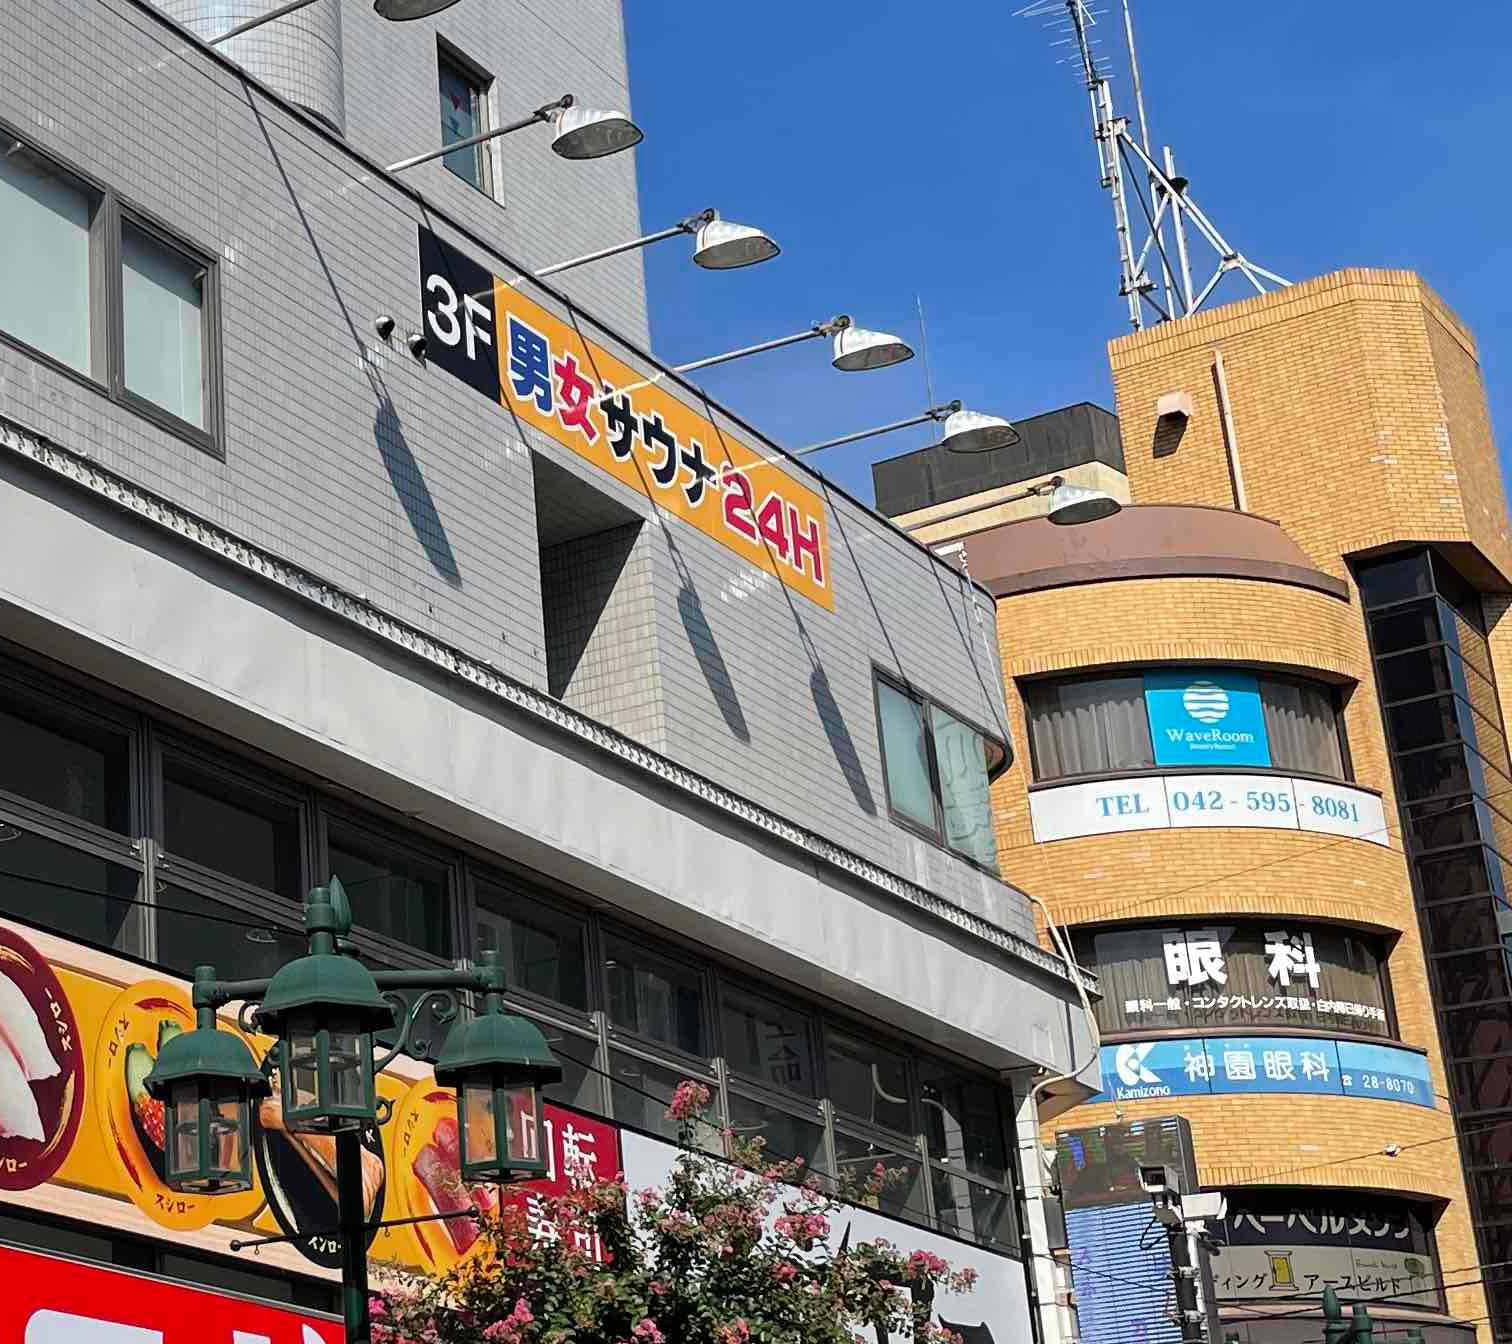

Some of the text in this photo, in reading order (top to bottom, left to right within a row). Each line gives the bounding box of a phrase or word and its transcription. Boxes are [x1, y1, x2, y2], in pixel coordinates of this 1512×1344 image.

[425, 273, 492, 360] 3F
[1165, 727, 1255, 744] WaveRoom
[1096, 793, 1150, 818] TEL
[1162, 929, 1321, 989] 眼科
[1183, 1050, 1330, 1083] 神園眼科
[1116, 1086, 1171, 1101] Kamizono
[1361, 1072, 1415, 1095] 28-8070
[153, 1193, 196, 1215] スシロー
